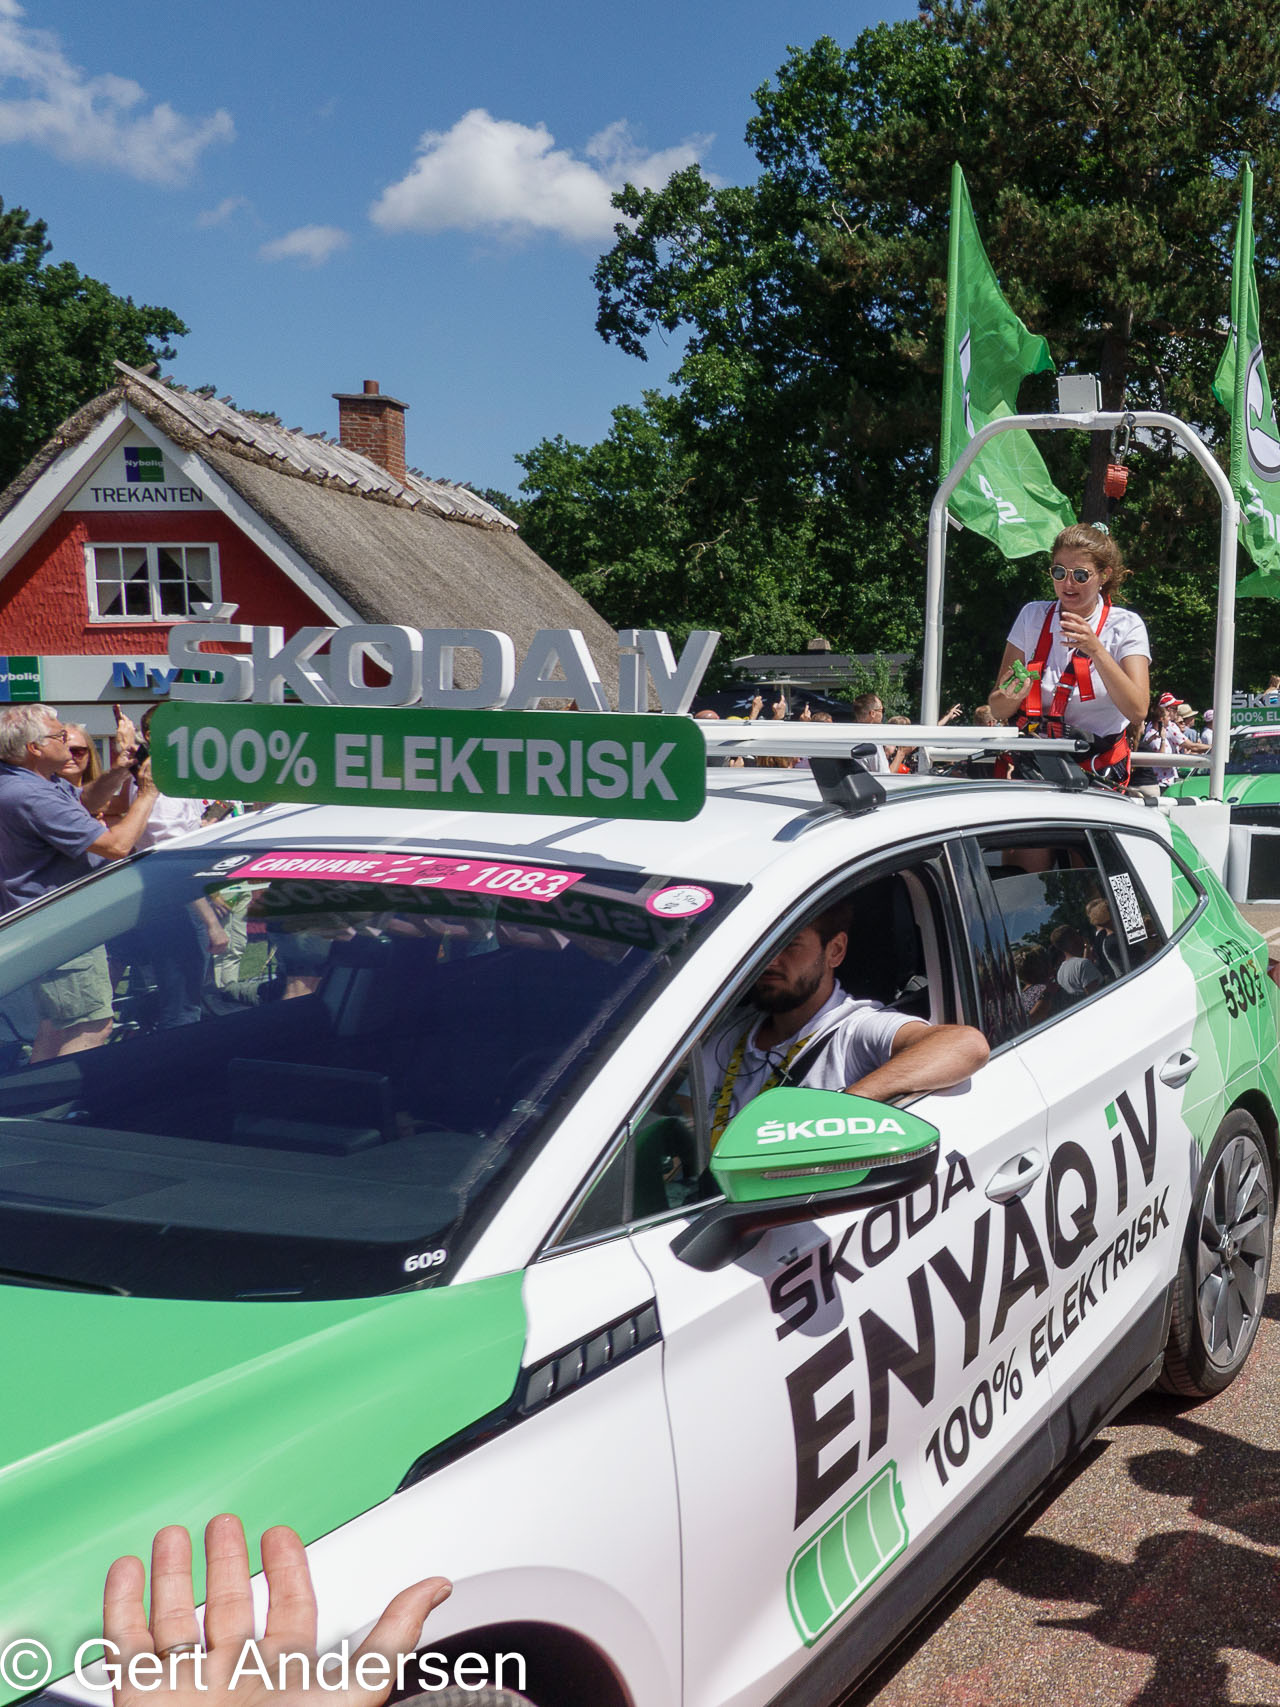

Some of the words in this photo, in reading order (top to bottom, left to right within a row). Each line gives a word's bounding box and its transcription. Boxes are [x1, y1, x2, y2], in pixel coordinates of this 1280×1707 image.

[90, 486, 204, 503] TREKANTEN
[168, 602, 611, 711] ŠKODA
[0, 672, 41, 683] ybolig
[1231, 711, 1264, 723] 100%
[167, 726, 318, 787] 100%
[335, 733, 679, 802] ELEKTRISK
[250, 858, 383, 876] CARAVANE
[467, 866, 569, 895] 1083
[1213, 944, 1235, 966] OP
[1225, 938, 1249, 958] TIL
[757, 1117, 906, 1145] ŠKODA
[404, 1247, 448, 1272] 609
[770, 1149, 975, 1342] ŠKODA
[785, 1140, 1099, 1532] ENYAQ
[1104, 1065, 1158, 1217] iV
[925, 1347, 1023, 1487] 100%
[1030, 1184, 1170, 1378] ELEKTRISK
